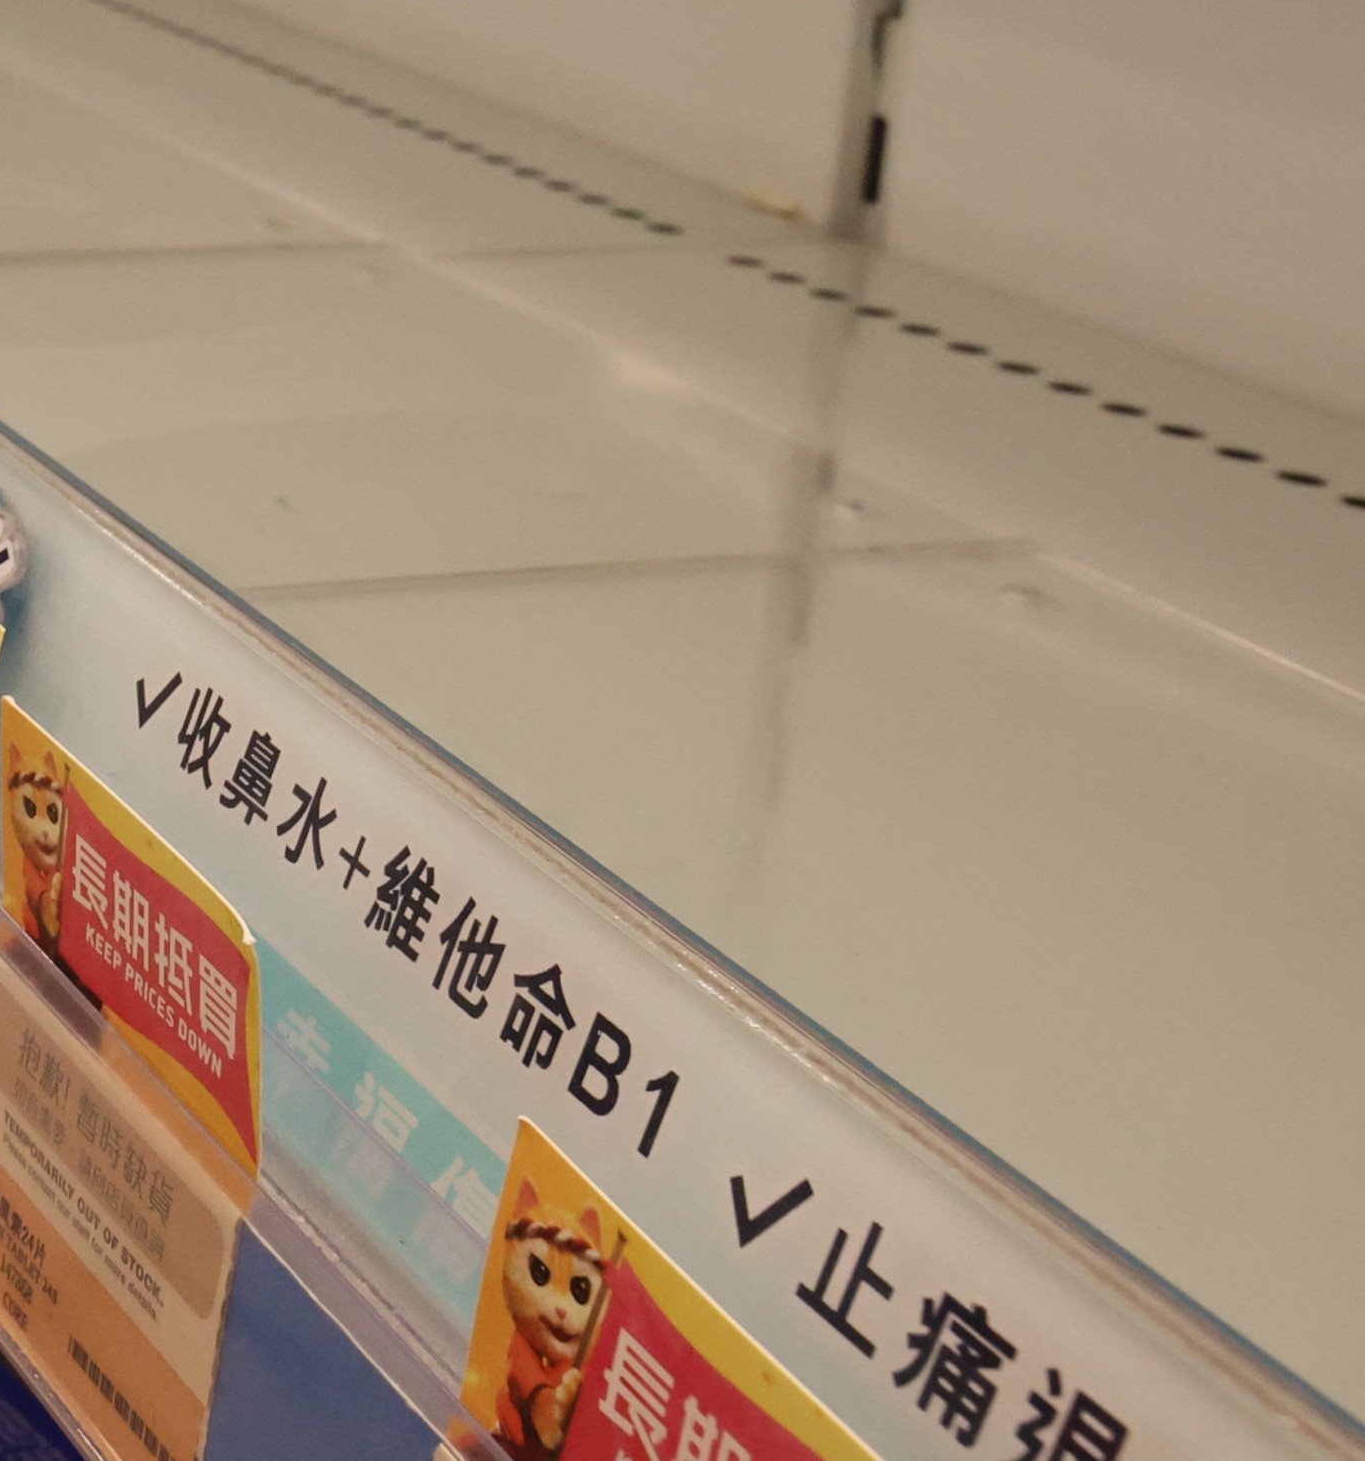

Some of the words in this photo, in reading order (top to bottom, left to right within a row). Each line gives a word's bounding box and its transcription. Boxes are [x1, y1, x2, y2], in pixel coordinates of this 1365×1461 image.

[71, 833, 238, 1061] 長期抵買
[85, 922, 122, 970] KEEP
[125, 962, 175, 1028] PRICES
[178, 1017, 223, 1079] DOWN
[3, 1109, 75, 1200] TEMPORARILY
[76, 1196, 102, 1231] OUT
[103, 1227, 119, 1250] OF
[120, 1246, 165, 1308] STOCK.
